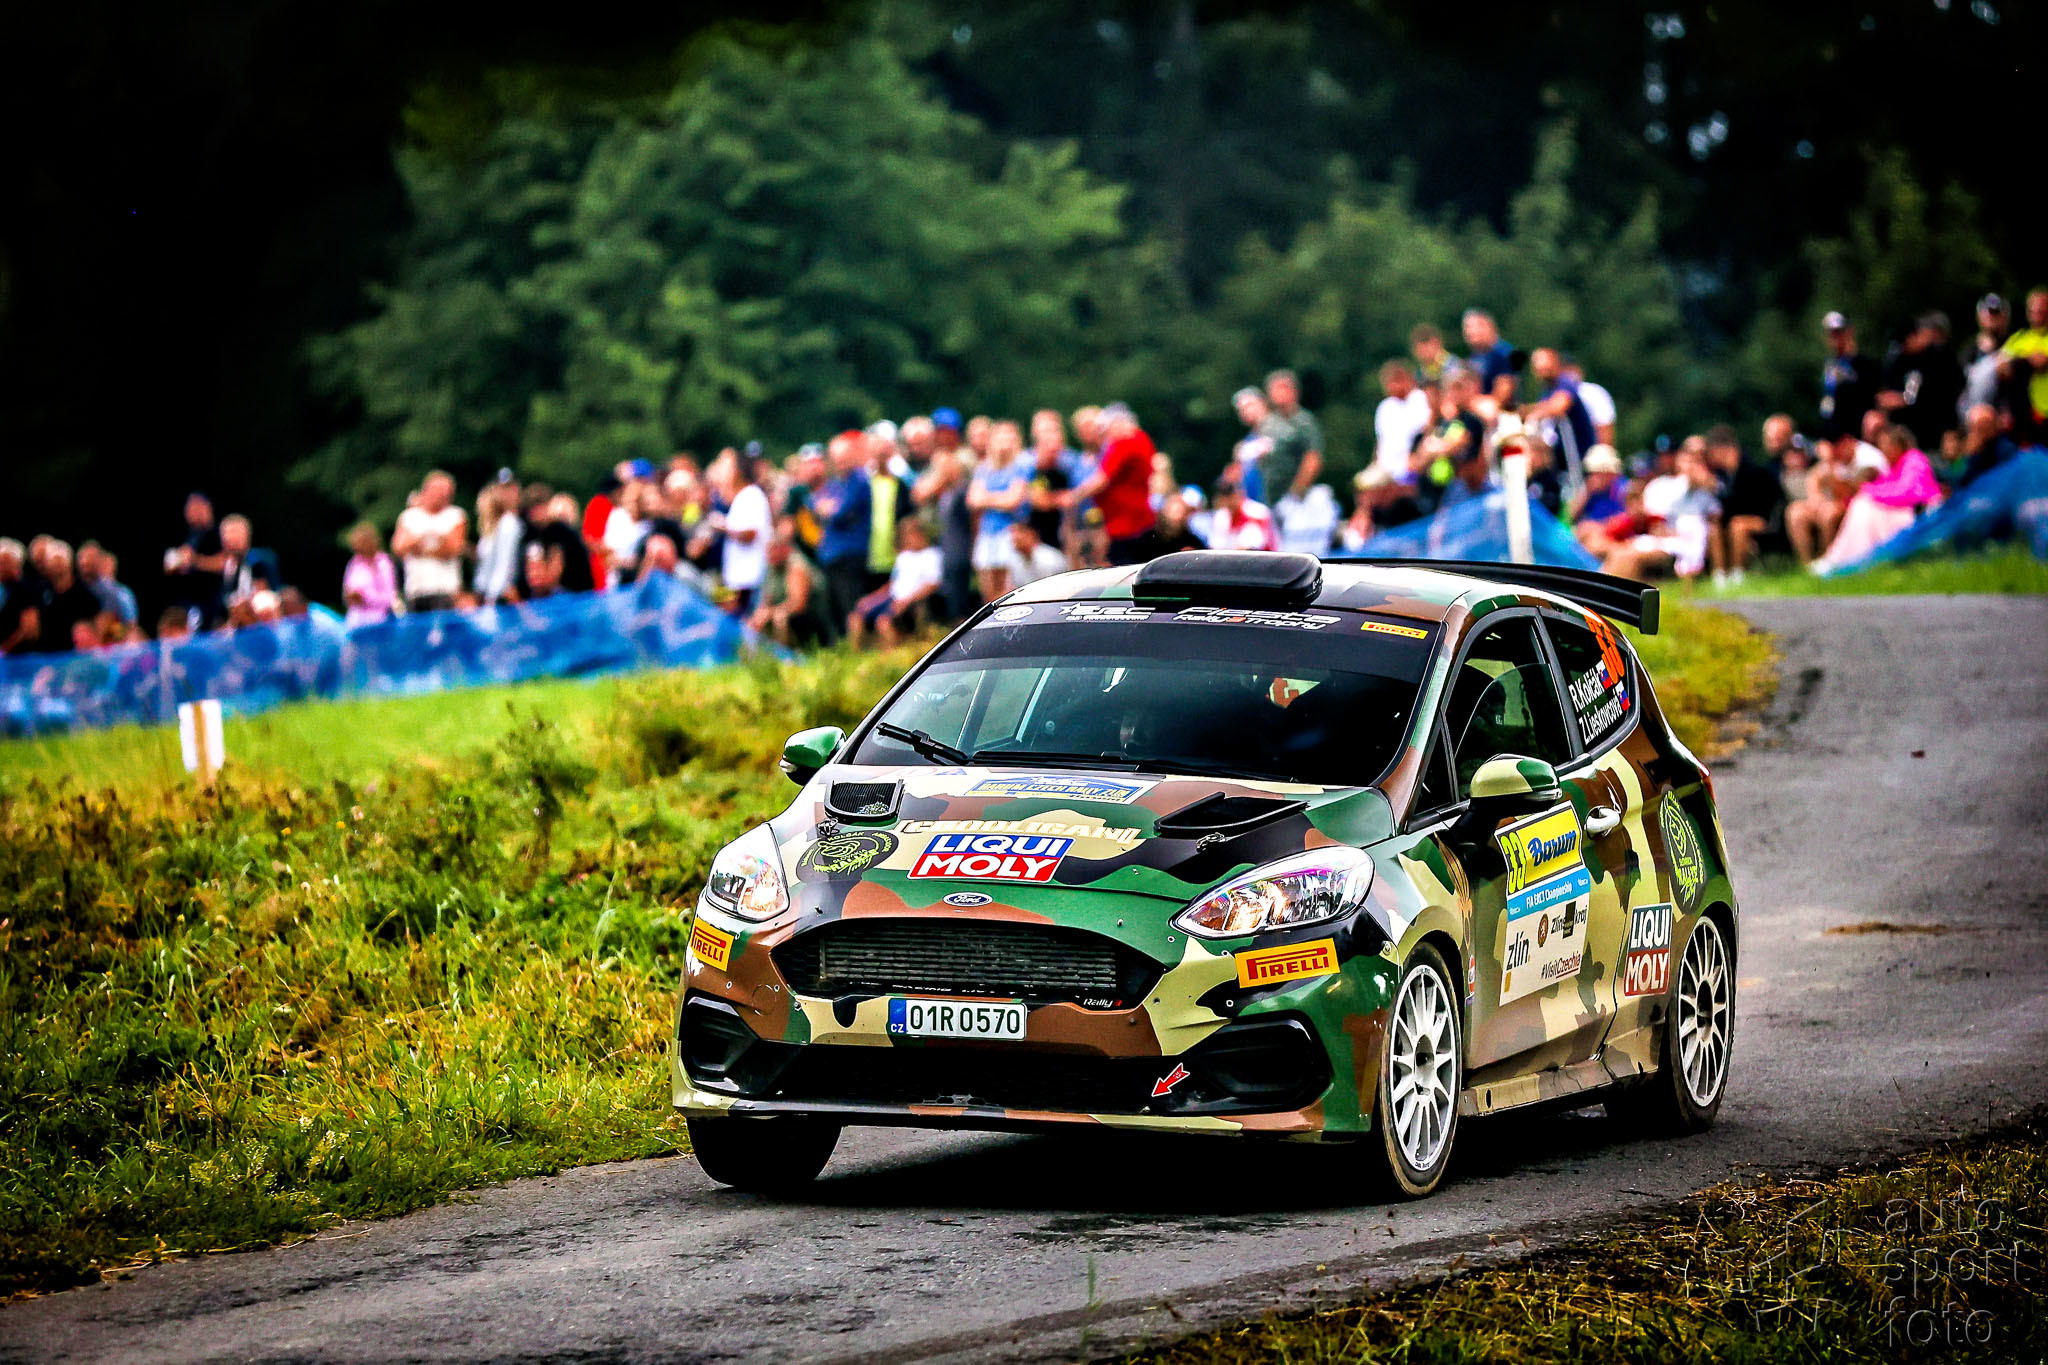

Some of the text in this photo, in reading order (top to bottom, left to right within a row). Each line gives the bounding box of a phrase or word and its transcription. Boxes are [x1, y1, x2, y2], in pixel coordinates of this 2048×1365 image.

[1178, 606, 1342, 624] Fiesta
[1245, 617, 1327, 630] Trophy
[931, 835, 1063, 855] LIQUI
[917, 854, 1059, 879] MOLY
[1501, 829, 1577, 894] 33 Barum
[953, 893, 982, 904] Ford
[1525, 896, 1533, 909] FIA
[1631, 908, 1670, 949] LIQUI
[691, 926, 727, 962] PIRELLI
[1506, 930, 1530, 971] zlín
[1246, 947, 1330, 980] PIRELLI
[1541, 950, 1581, 980] #VisitCzechia
[1625, 951, 1669, 993] MOLY
[890, 1005, 1021, 1034] CZ 01R 0570
